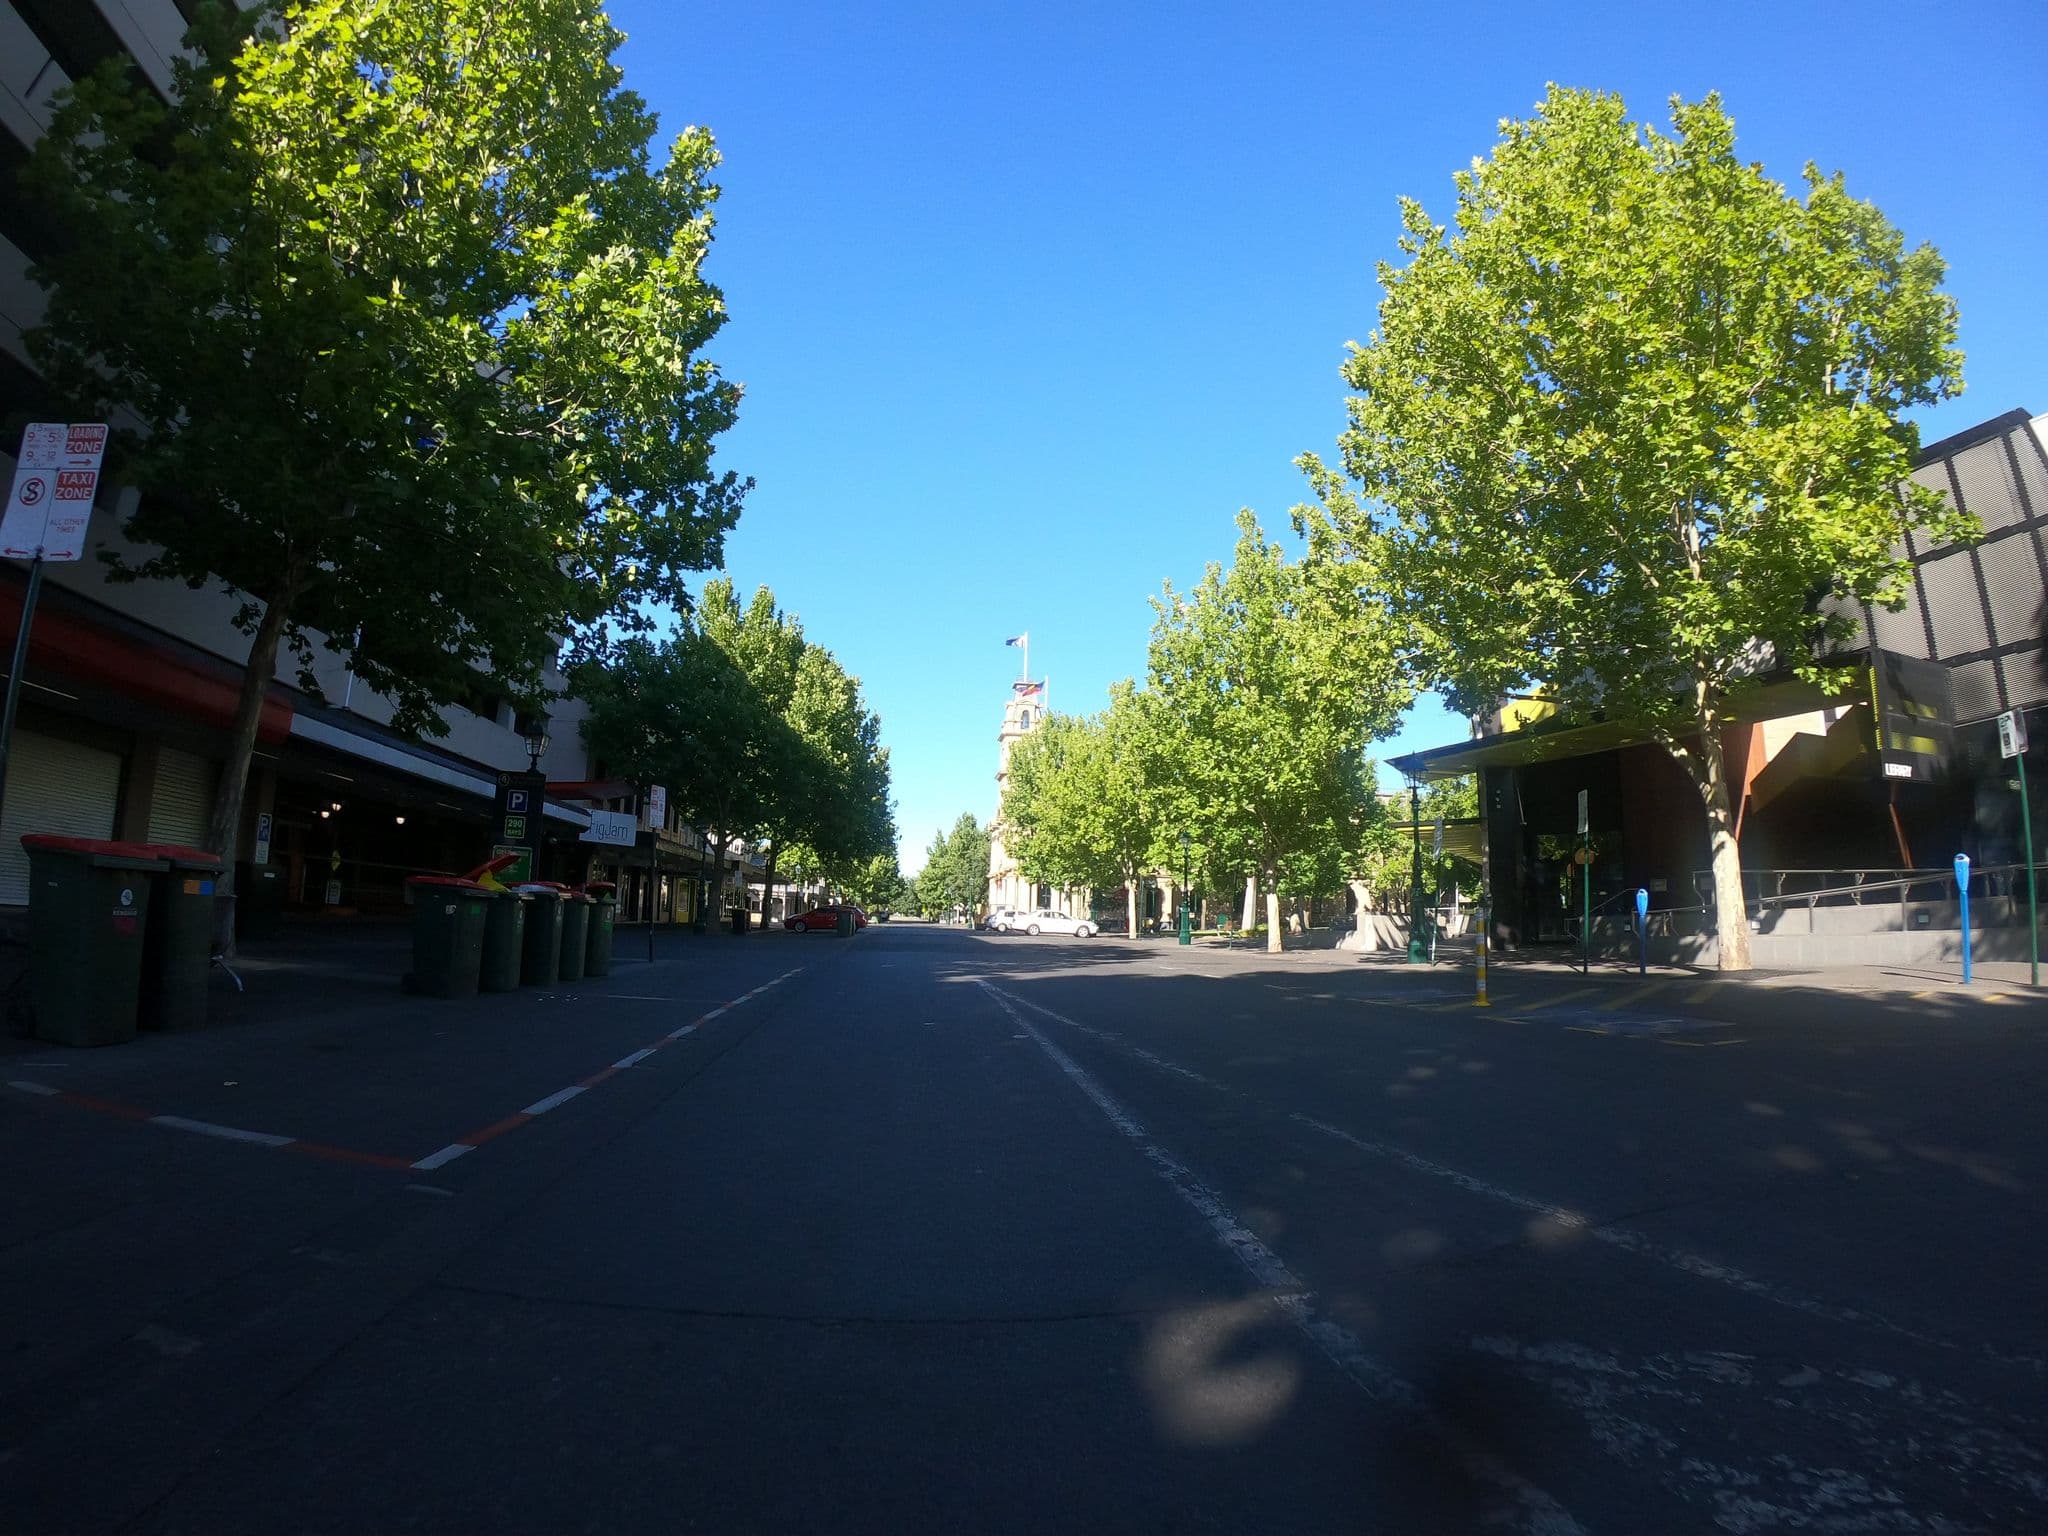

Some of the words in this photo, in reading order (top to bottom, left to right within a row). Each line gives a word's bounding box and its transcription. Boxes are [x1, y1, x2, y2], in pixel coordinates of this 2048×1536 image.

[69, 427, 105, 439] LOADING
[65, 441, 102, 453] ZONE
[62, 472, 93, 485] TAXI
[55, 487, 92, 499] ZONE
[512, 793, 523, 808] P
